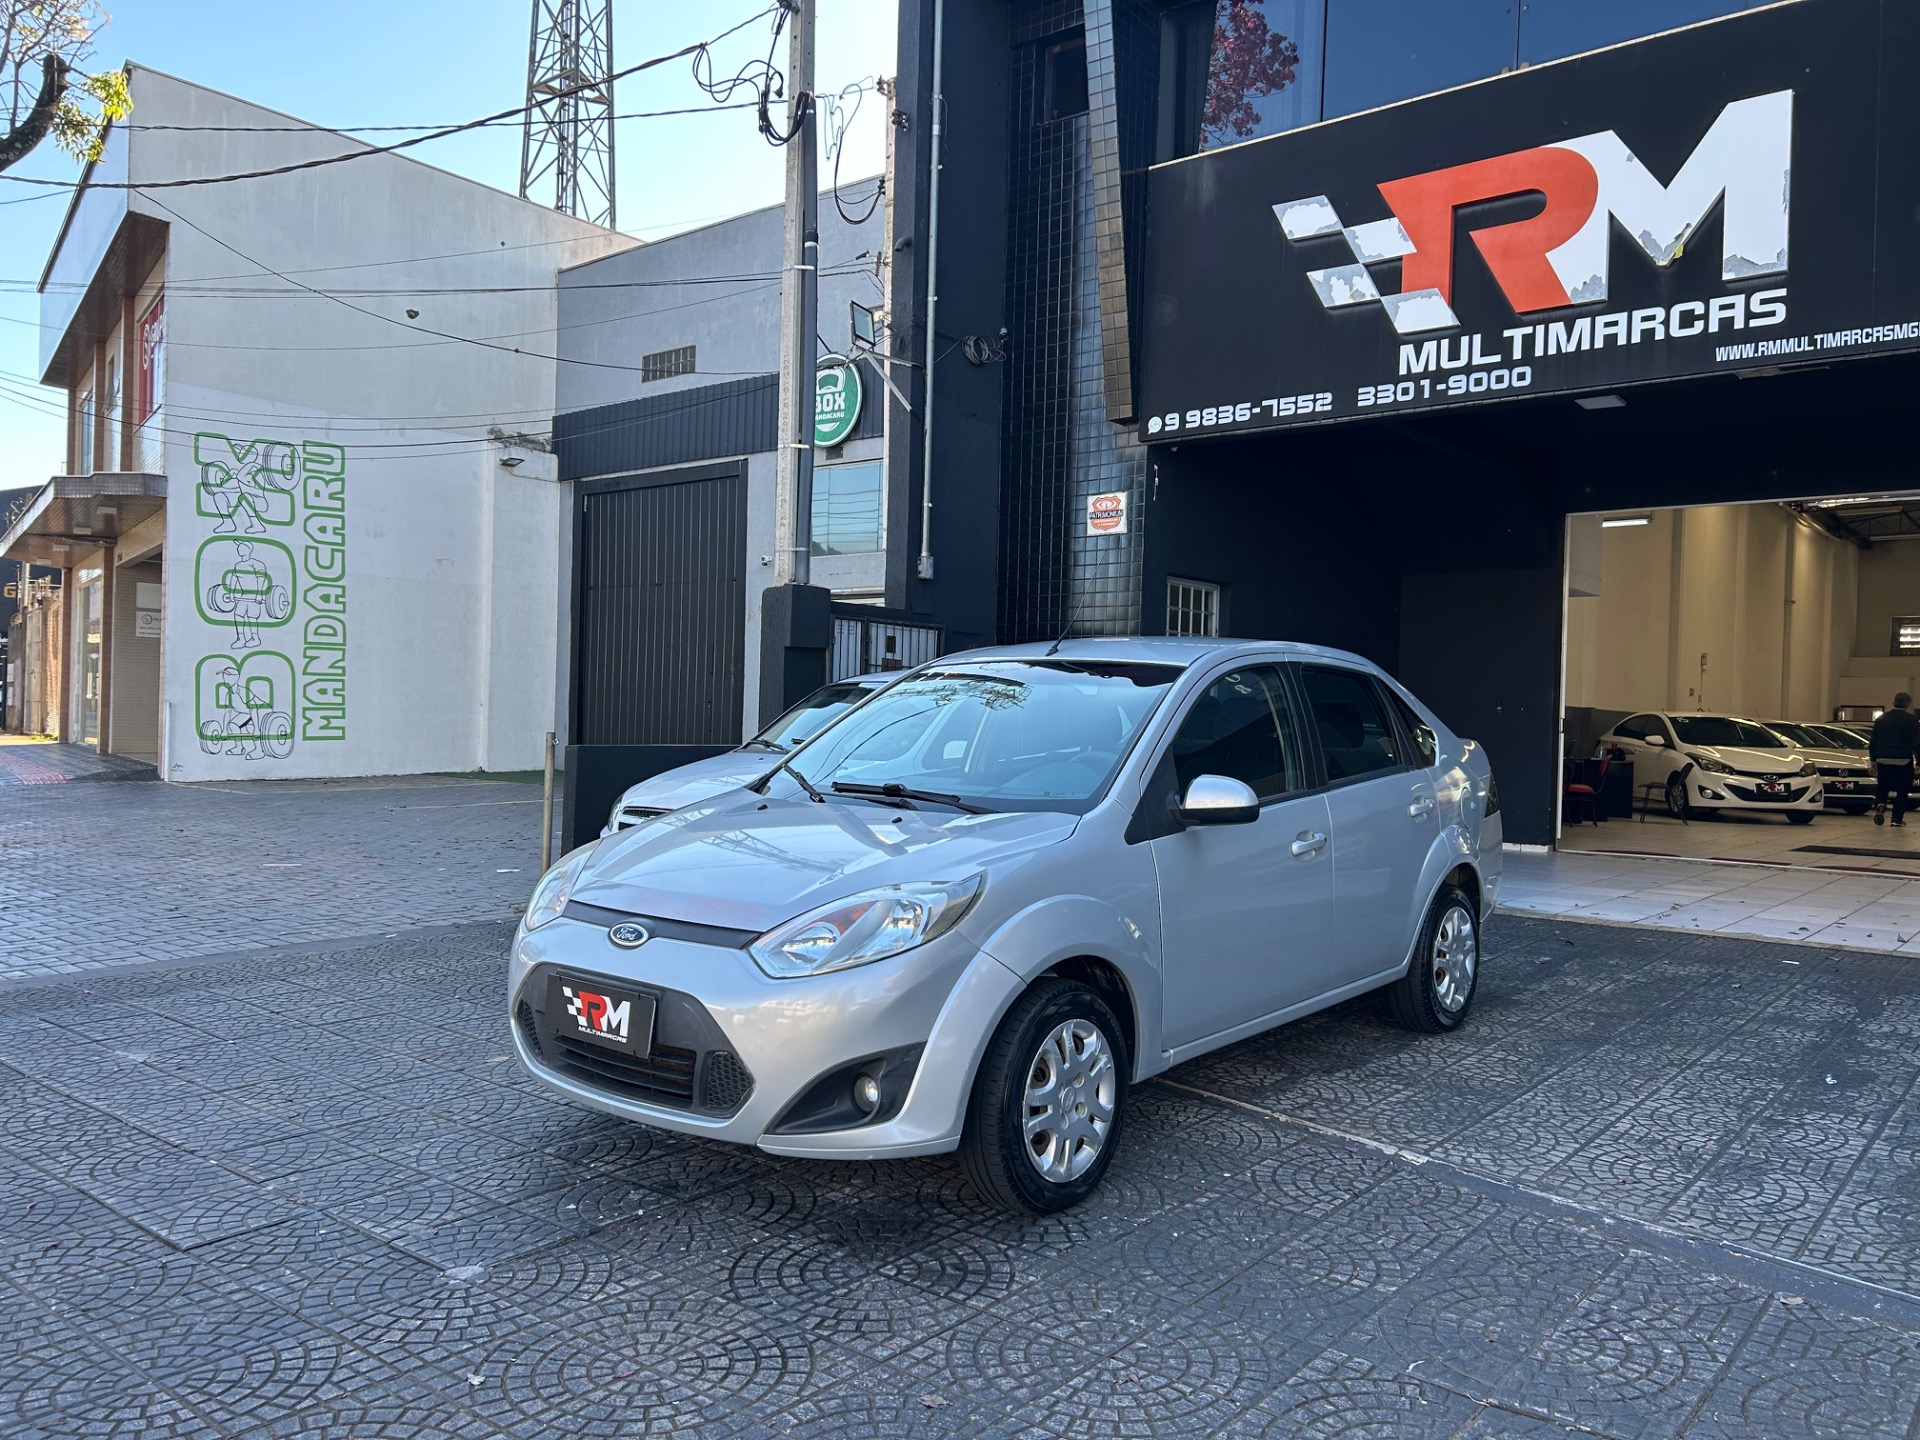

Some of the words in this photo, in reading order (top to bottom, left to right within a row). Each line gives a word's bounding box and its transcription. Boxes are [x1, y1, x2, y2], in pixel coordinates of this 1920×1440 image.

[1377, 88, 1793, 315] RM
[1399, 288, 1788, 375] MULTIMARCAS
[1715, 321, 1920, 362] WWW.RMMULTIMARCASMG
[815, 411, 845, 421] ANDACARU
[1164, 411, 1180, 432] 9
[1185, 391, 1333, 429] 9836-7552
[1357, 366, 1532, 407] 3301-9000
[194, 431, 296, 740] BOX
[301, 439, 347, 742] MANDACARU
[616, 927, 638, 940] Ford
[578, 990, 631, 1037] RM
[578, 1025, 628, 1043] MULTIMARCAS
